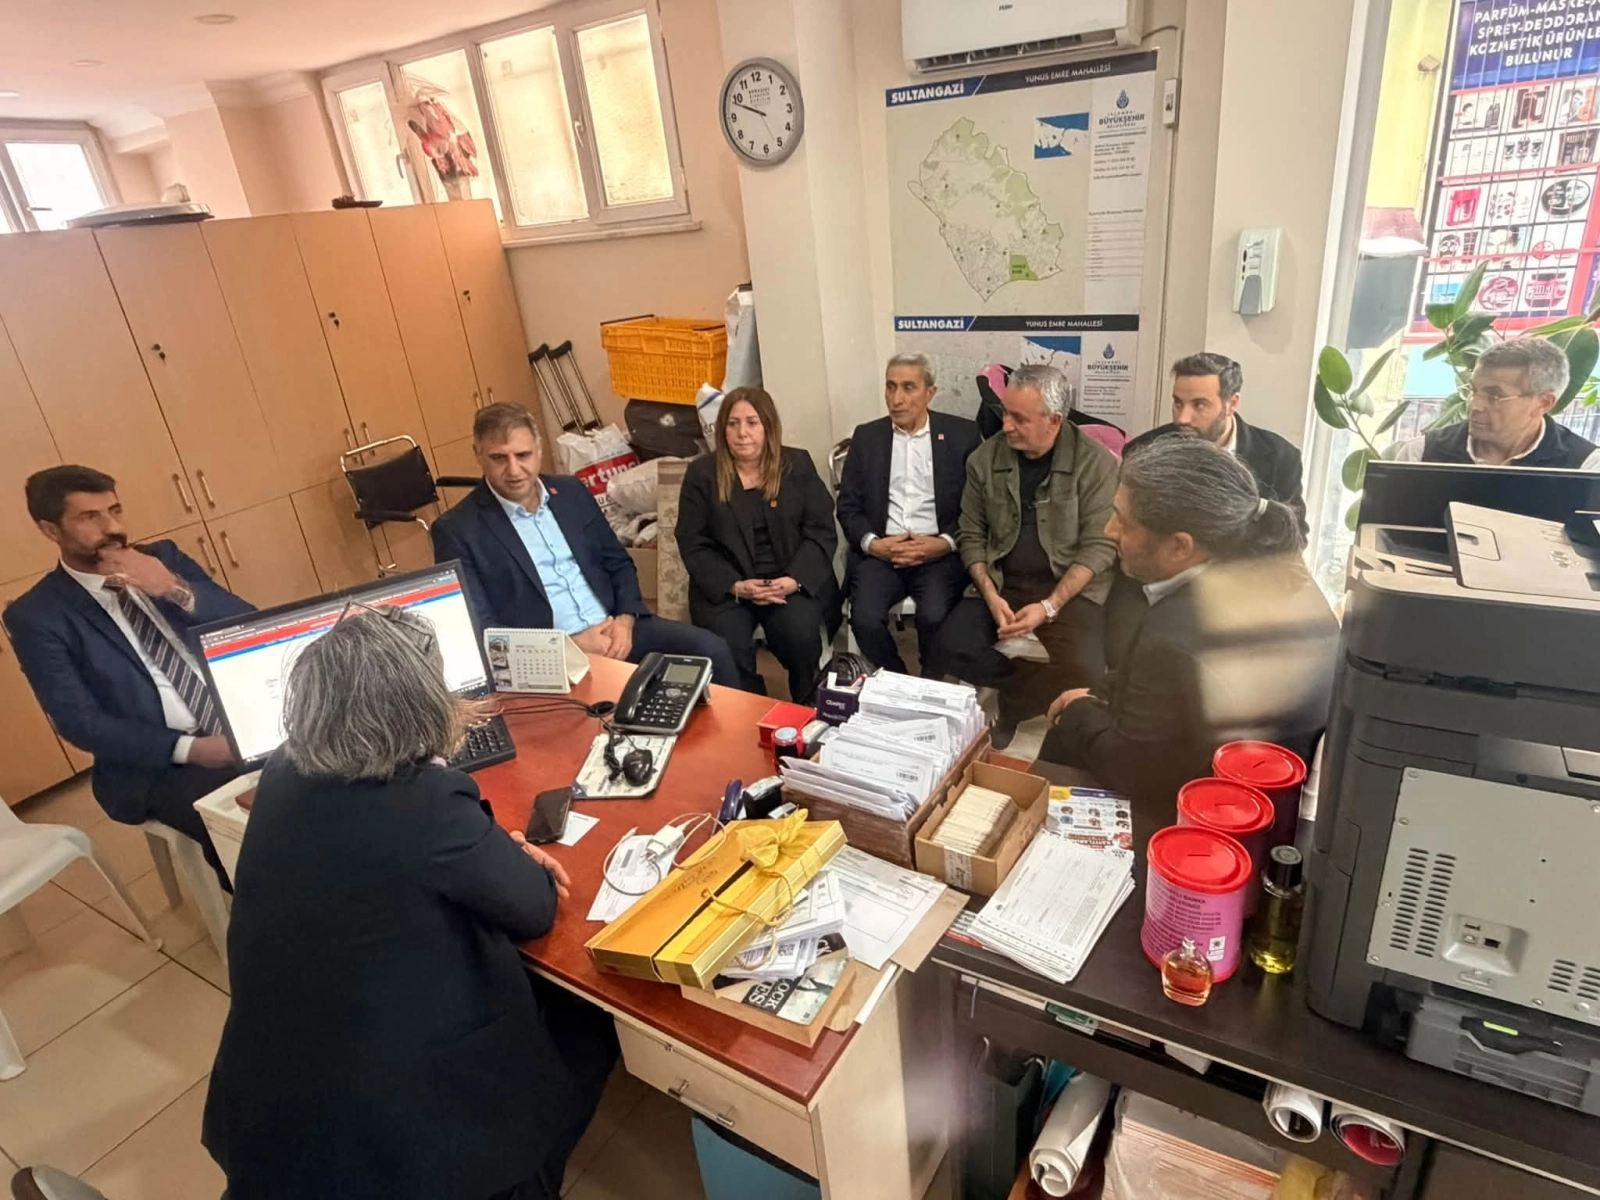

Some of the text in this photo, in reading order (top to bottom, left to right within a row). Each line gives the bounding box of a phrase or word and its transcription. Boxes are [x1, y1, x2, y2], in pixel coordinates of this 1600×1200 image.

[1505, 47, 1573, 67] BULUNUR
[750, 71, 761, 83] 12
[1025, 64, 1112, 83] YUNUS EMRE MAHALLESİ
[739, 79, 748, 90] 11
[768, 74, 773, 85] 1
[779, 85, 786, 95] 2
[891, 82, 965, 104] SULTANGAZİ
[733, 93, 743, 104] 10
[786, 103, 793, 113] 3
[731, 113, 737, 122] 9
[785, 121, 791, 131] 4
[737, 129, 744, 140] 8
[749, 140, 755, 150] 7
[776, 136, 783, 147] 5
[763, 144, 769, 154] 6
[897, 318, 964, 330] SULTANGAZİ
[1025, 318, 1103, 328] YUNUS EMRE MAHALLESİ
